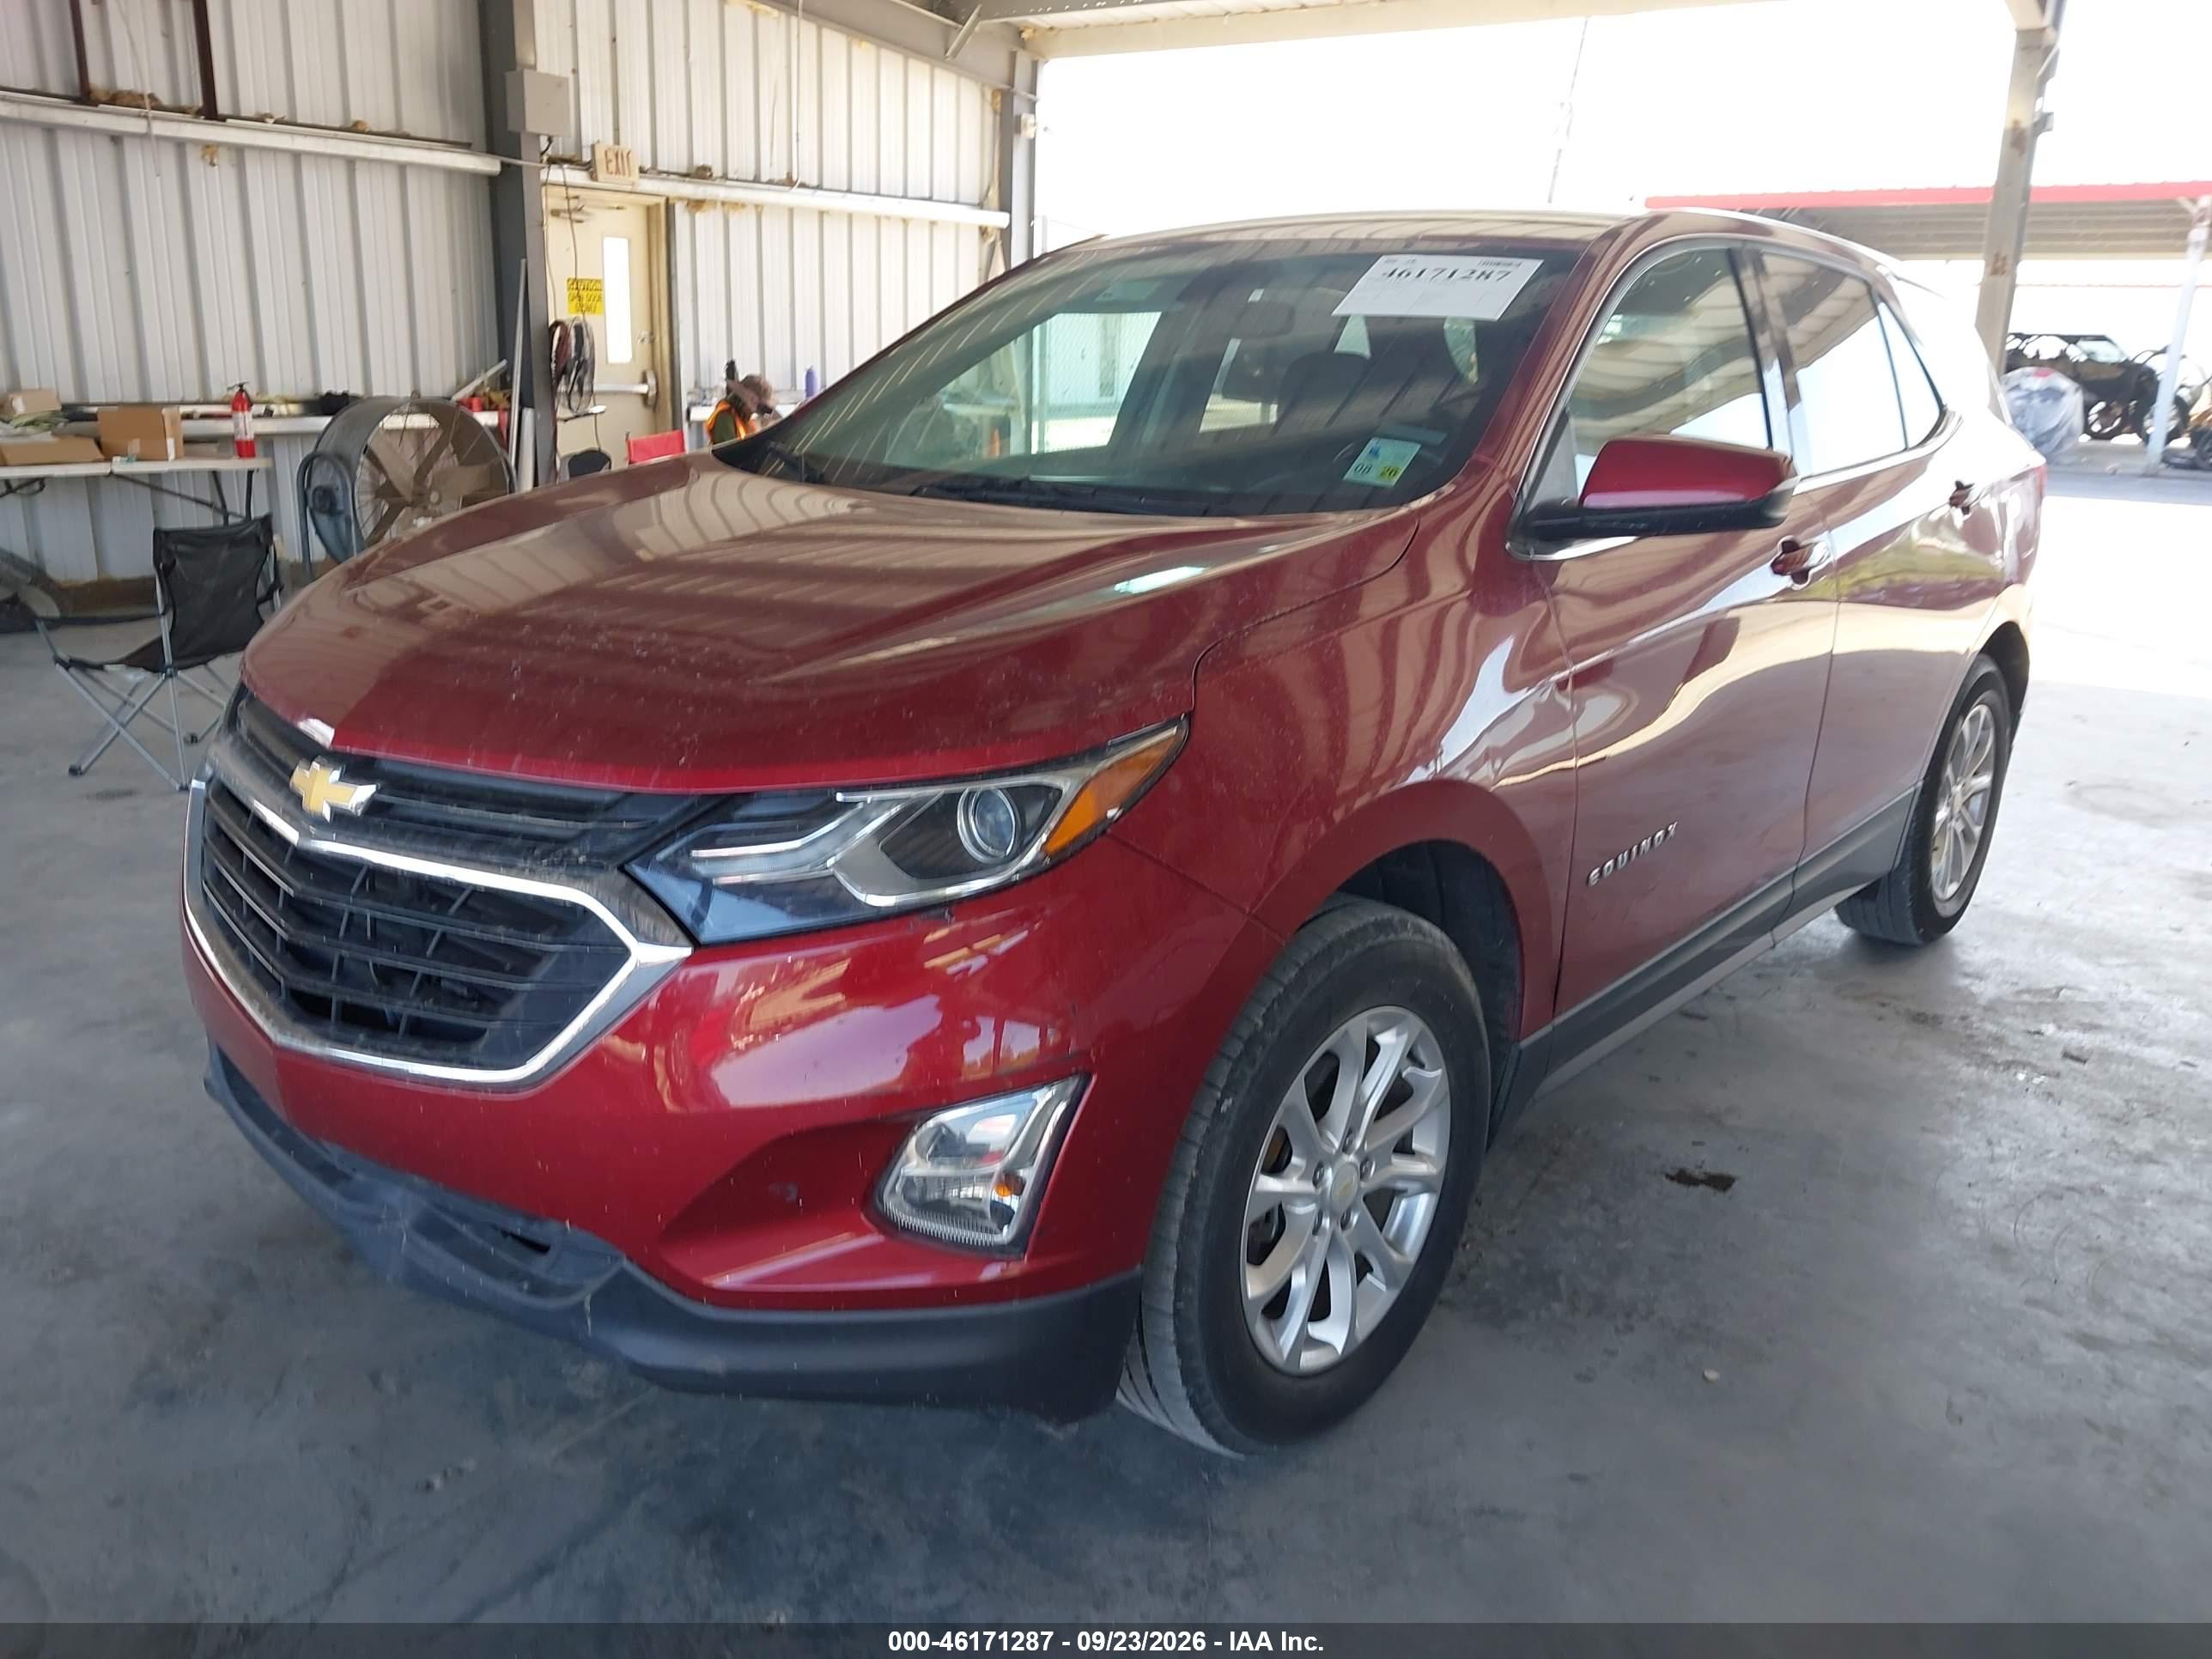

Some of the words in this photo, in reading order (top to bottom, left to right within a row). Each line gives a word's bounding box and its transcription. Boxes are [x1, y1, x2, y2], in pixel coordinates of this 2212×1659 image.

[604, 149, 632, 177] EXIT
[1382, 267, 1512, 283] 46171287
[1586, 820, 1679, 887] EQUINOX
